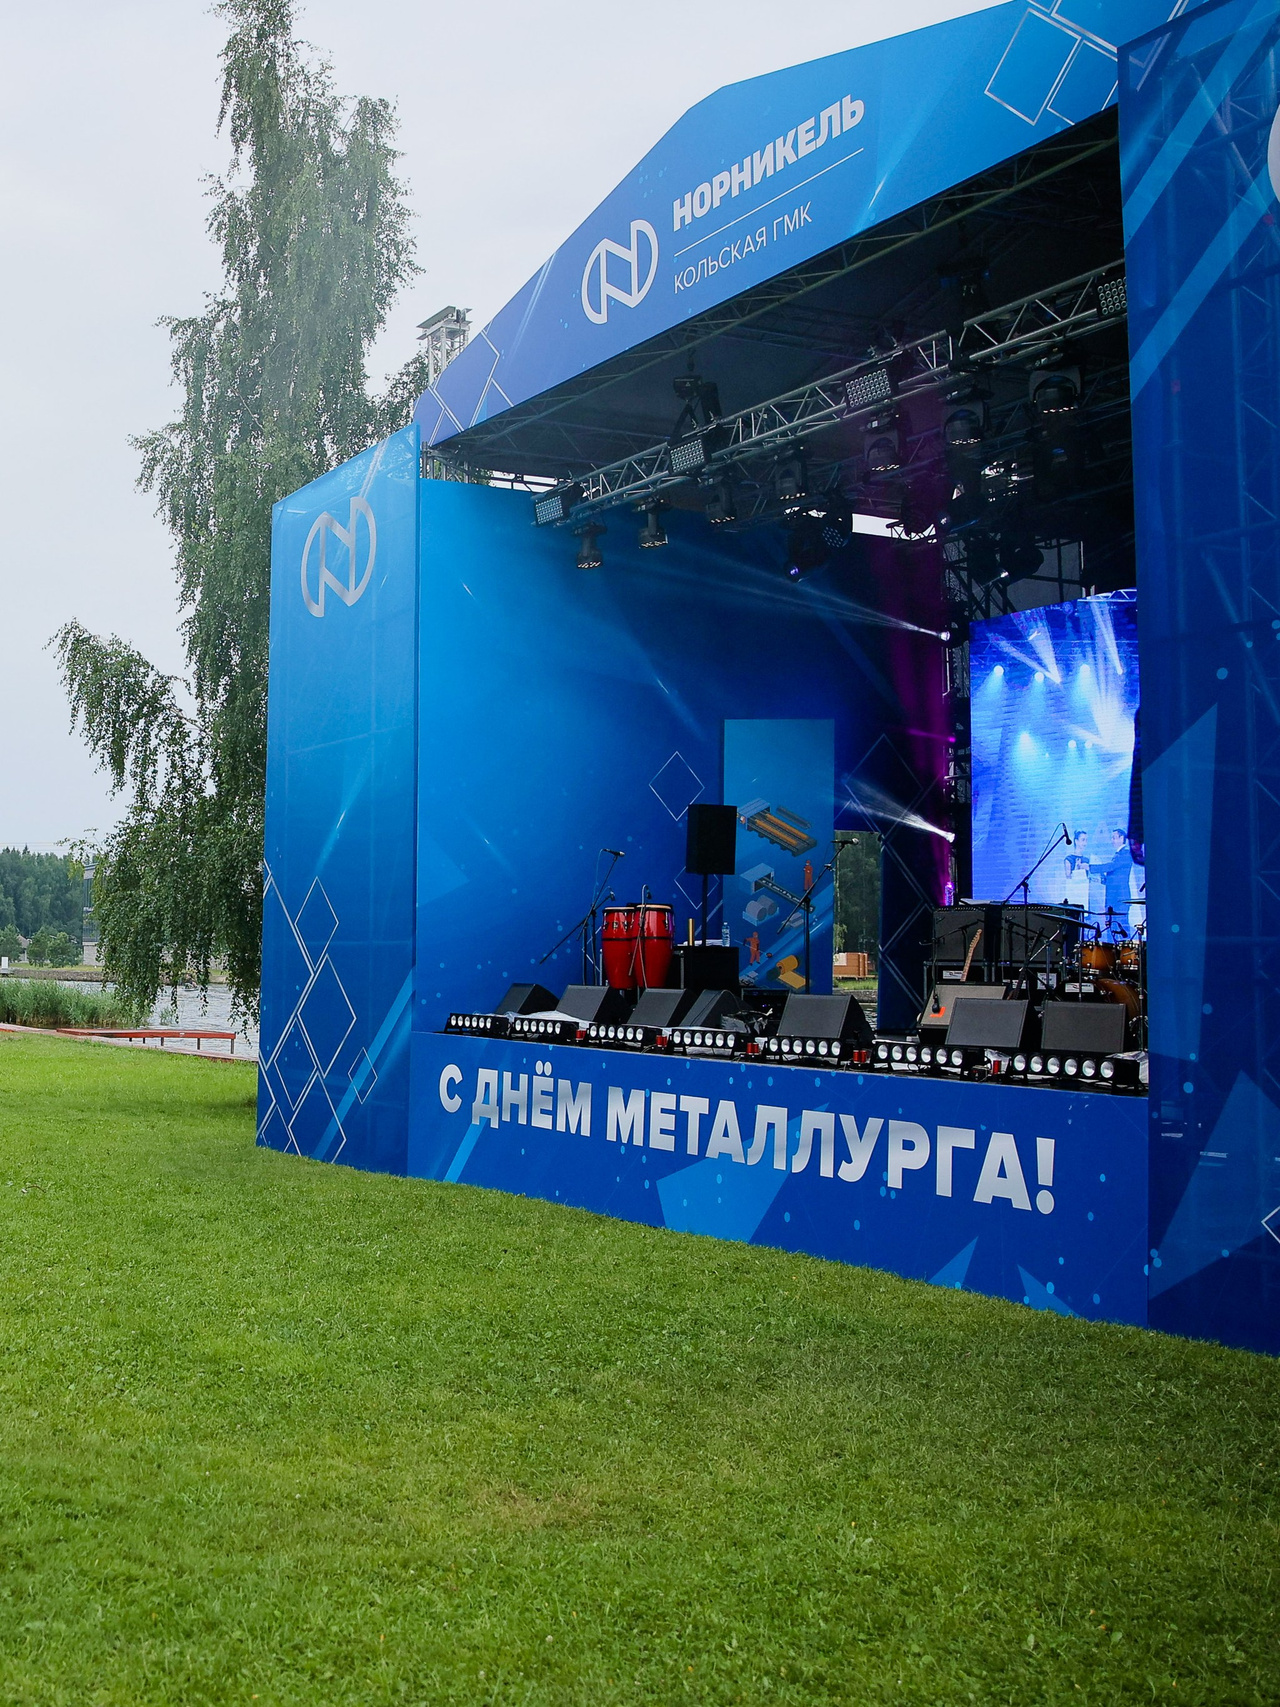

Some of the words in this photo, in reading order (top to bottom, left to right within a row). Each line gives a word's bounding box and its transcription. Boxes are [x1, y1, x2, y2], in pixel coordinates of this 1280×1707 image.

[672, 93, 865, 233] НОРНИКЕЛЬ
[674, 233, 768, 295] КОЛЬСКАЯ
[772, 201, 813, 242] ГМК
[438, 1063, 463, 1114] С
[471, 1060, 593, 1138] ДНЁМ
[606, 1086, 1056, 1216] МЕТАЛЛУРГА!
